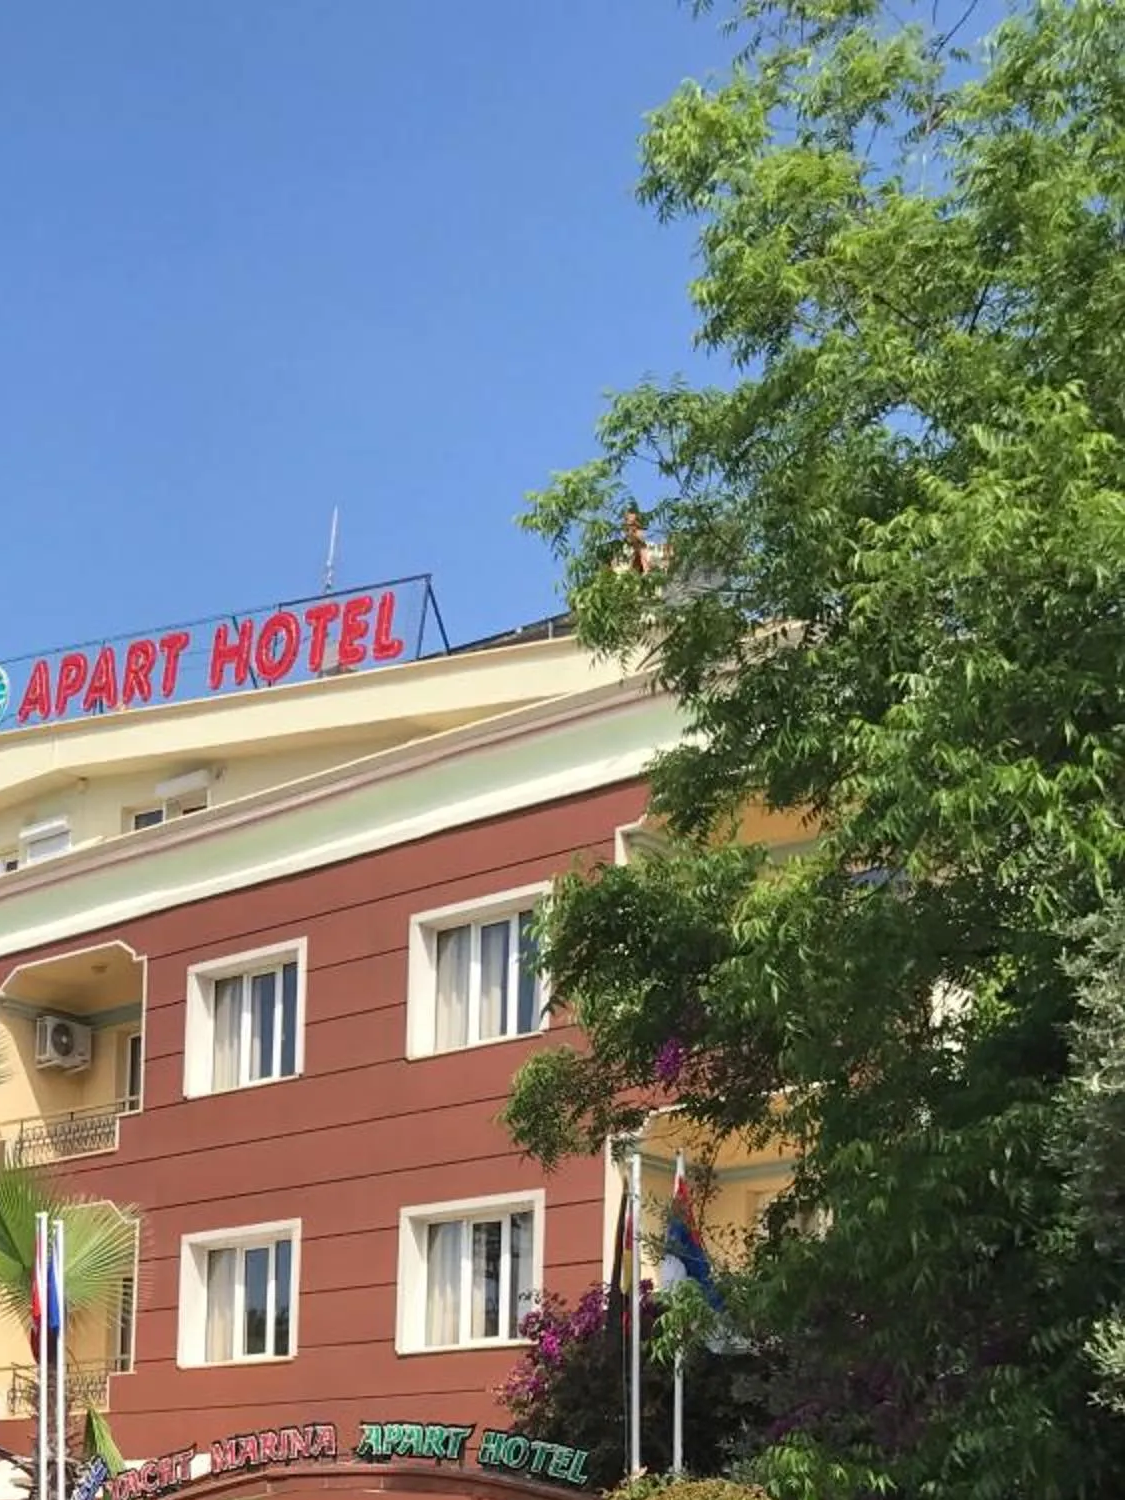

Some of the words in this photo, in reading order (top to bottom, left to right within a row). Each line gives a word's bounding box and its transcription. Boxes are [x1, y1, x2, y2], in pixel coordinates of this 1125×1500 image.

[16, 630, 192, 724] APART
[209, 590, 405, 690] HOTEL
[210, 1423, 337, 1473] MARINA
[355, 1421, 475, 1459] APART
[478, 1429, 589, 1485] HOTEL
